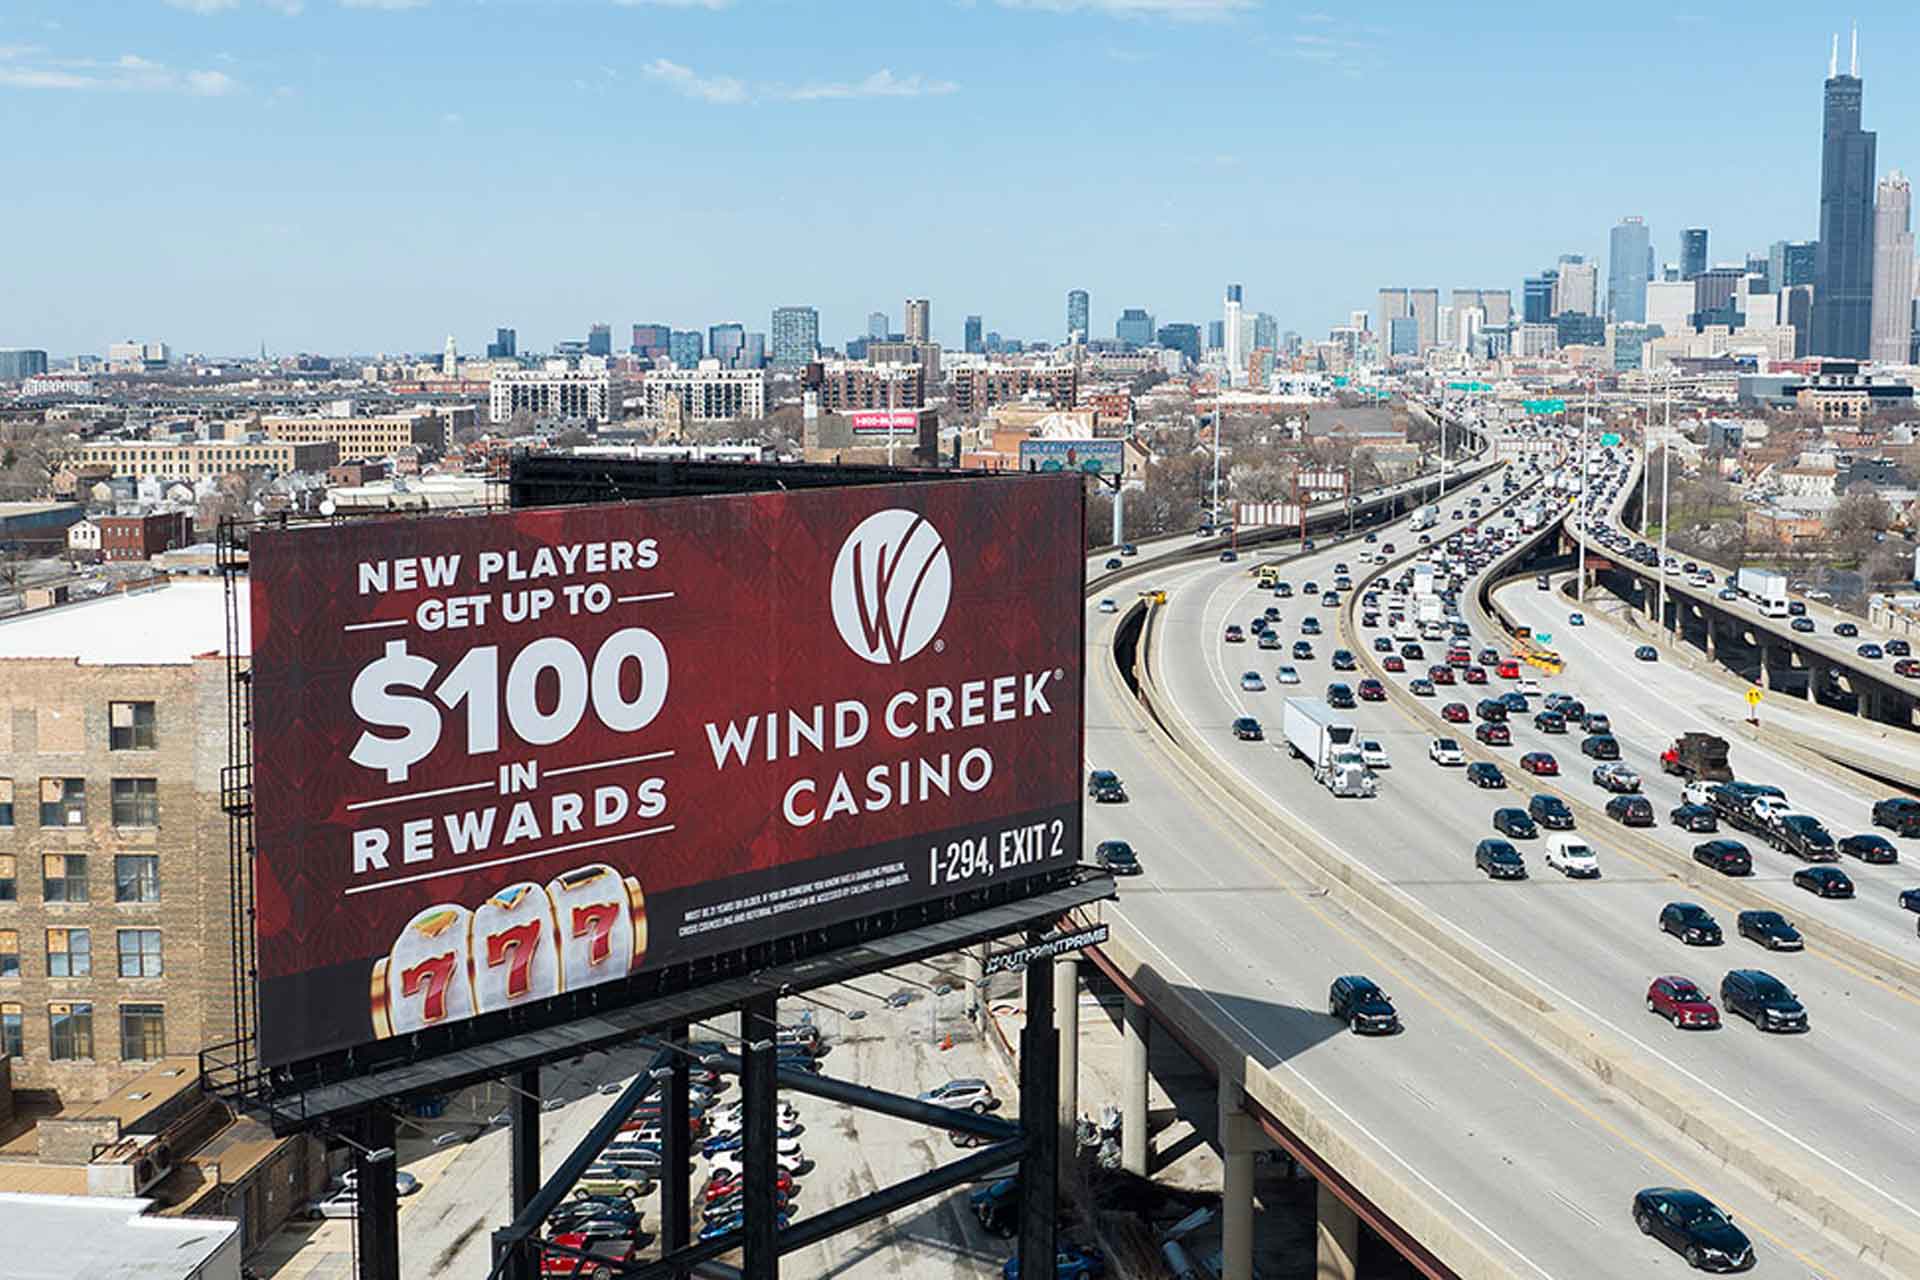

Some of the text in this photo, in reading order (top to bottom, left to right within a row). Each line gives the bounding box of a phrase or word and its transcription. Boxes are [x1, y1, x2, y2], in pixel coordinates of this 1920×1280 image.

[358, 538, 659, 595] NEW PLAYERS
[416, 583, 611, 632] GET UP TO
[349, 627, 670, 783] $100
[704, 700, 869, 771] WIND
[499, 760, 538, 795] IN
[782, 748, 993, 827] CASINO
[353, 778, 667, 874] REWARDS
[930, 819, 1064, 885] I-294, EXIT 2
[401, 950, 456, 1023] 7
[486, 918, 541, 1000] 7
[570, 903, 621, 967] 7
